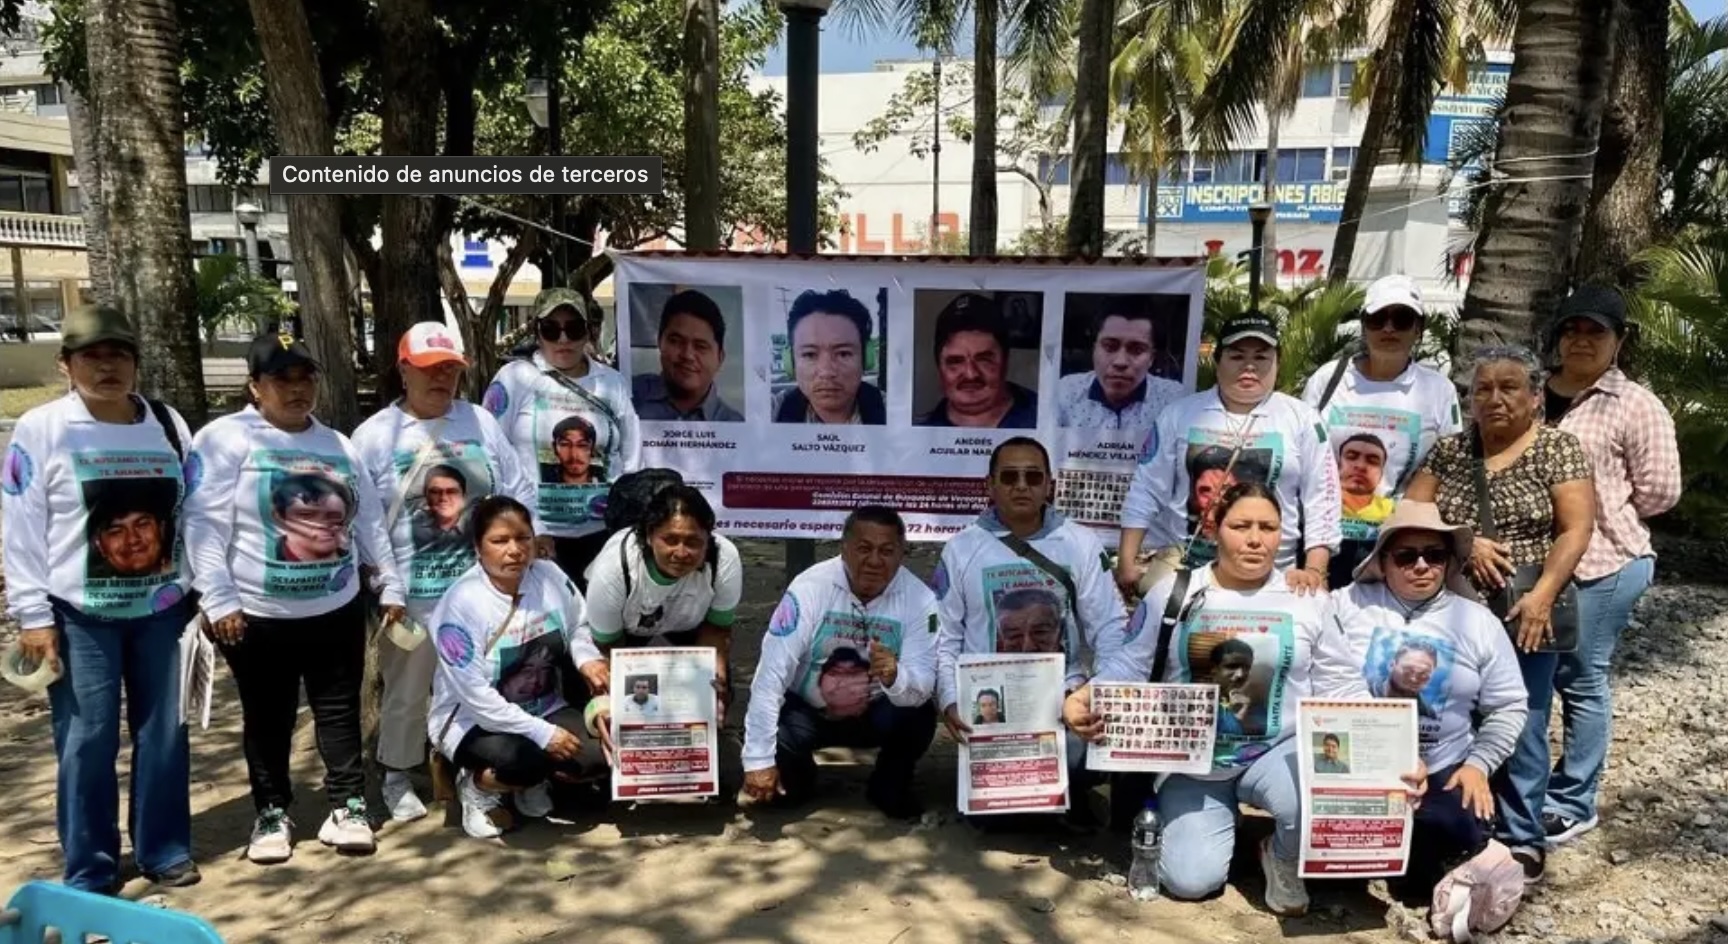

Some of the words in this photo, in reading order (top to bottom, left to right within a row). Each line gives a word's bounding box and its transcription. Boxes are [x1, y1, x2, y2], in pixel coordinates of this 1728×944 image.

[1186, 184, 1306, 204] INSCRIPCINES
[1309, 184, 1346, 204] ABIE
[696, 431, 716, 439] LUIS
[816, 432, 841, 442] SAÚL
[680, 439, 737, 449] HERNÁNDEZ
[954, 437, 993, 446] ANDRÉS
[1097, 441, 1135, 450] ADRIÁN
[792, 442, 820, 451] SALTO
[930, 447, 970, 455] AGUILAR
[972, 447, 992, 456] NAR
[799, 521, 844, 533] espera
[907, 523, 922, 534] 72
